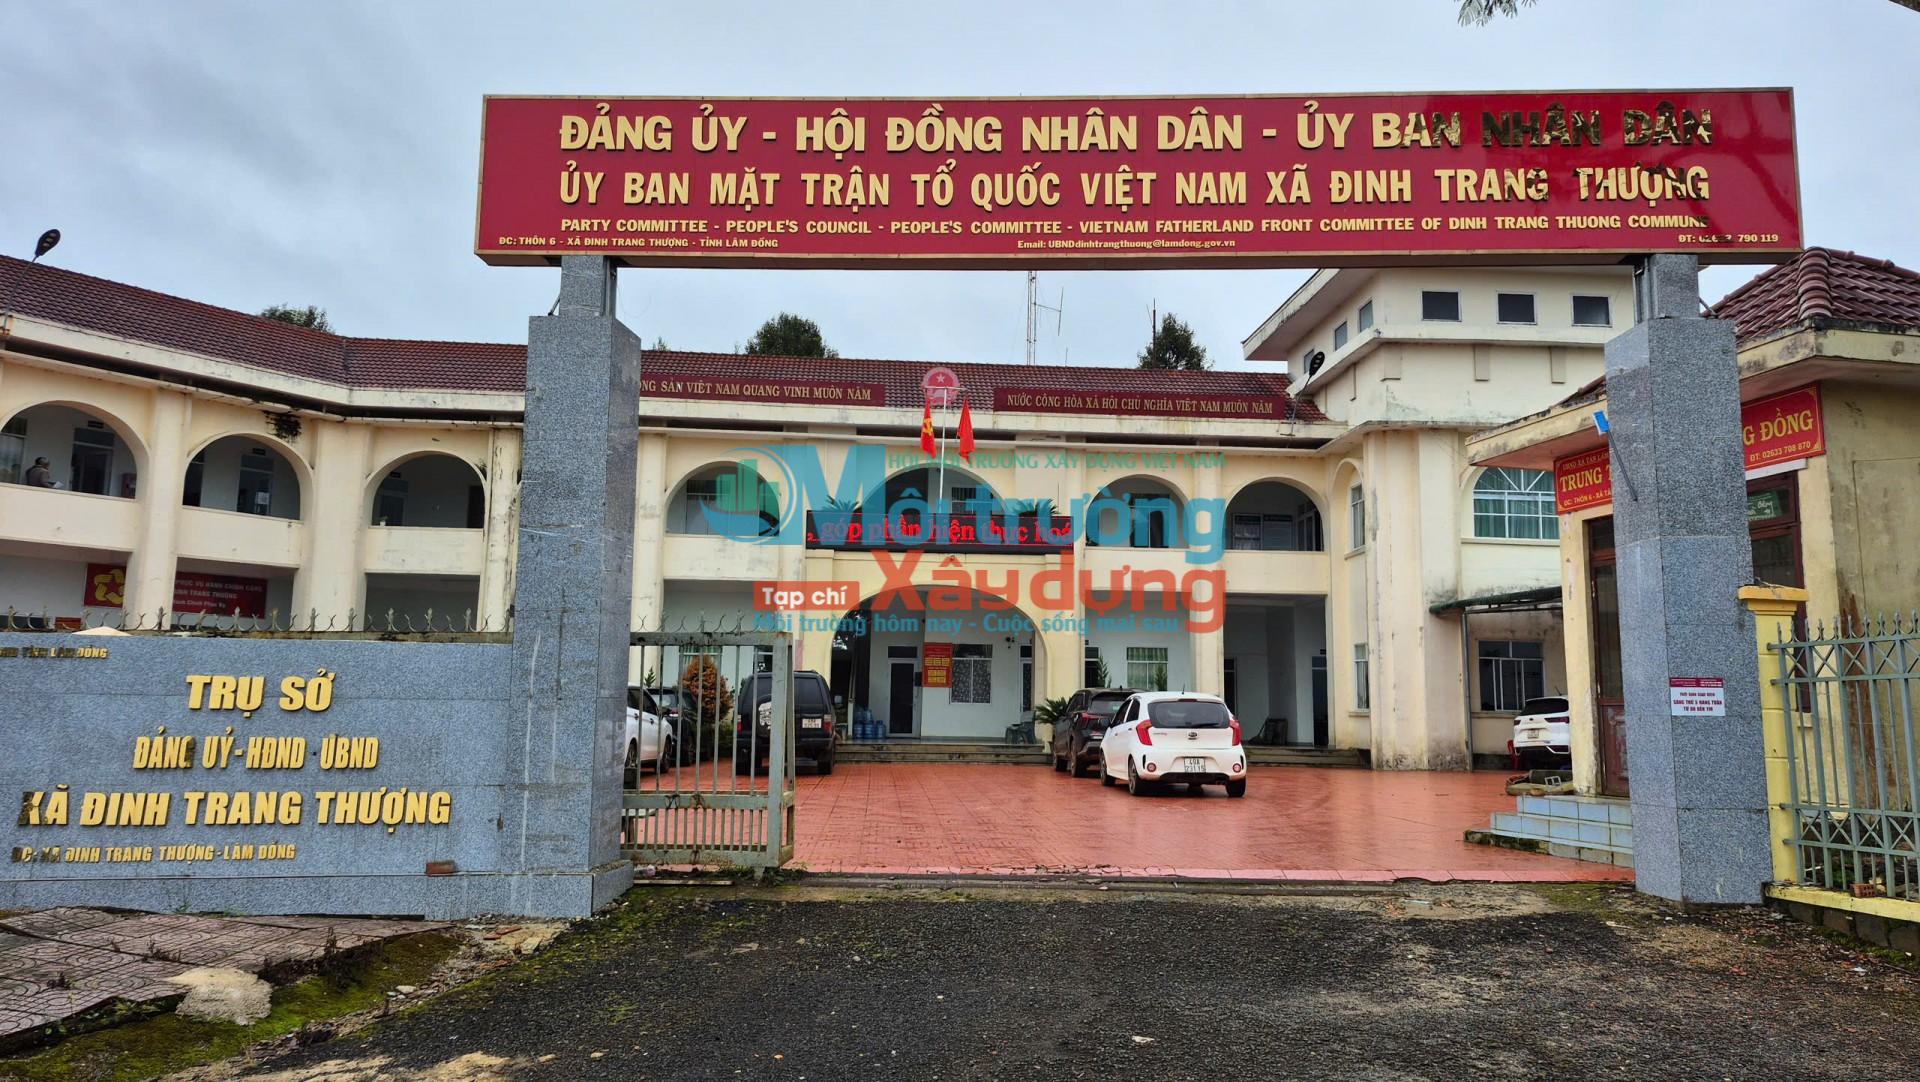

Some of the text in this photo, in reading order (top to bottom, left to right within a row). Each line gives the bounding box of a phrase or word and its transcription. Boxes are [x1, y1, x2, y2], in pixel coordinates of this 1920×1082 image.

[559, 104, 672, 152] ĐẢNG
[691, 104, 747, 152] ỦY
[795, 107, 866, 160] HỘI
[885, 103, 1002, 152] ĐỒNG
[1022, 107, 1138, 151] NHÂN
[1157, 106, 1243, 151] DÂN
[1297, 100, 1353, 150] ỦY
[1373, 111, 1461, 147] BAN
[1482, 102, 1601, 147] NHÂN
[1623, 101, 1714, 146] DÂN
[559, 158, 1709, 213] ỦY BAN MẶT TRẬN TỔ QUỐC VIỆT NAM XÃ ĐINH TRANG THƯỢNG
[561, 219, 610, 234] PARTY
[616, 219, 708, 234] COMMITTEE
[726, 219, 799, 234] PEOPLE'S
[806, 219, 872, 234] COUNCIL
[890, 219, 962, 234] PEOPLE'S
[970, 219, 1061, 234] COMMITTEE
[1079, 219, 1149, 234] VIETNAM
[1155, 219, 1254, 233] FATHERLAND
[1261, 218, 1314, 232] FRONT
[1319, 217, 1414, 232] COMMITTEE
[1421, 217, 1442, 231] OF
[1449, 216, 1487, 231] DINH
[1494, 216, 1550, 230] TRANG
[1556, 215, 1621, 230] THUONG
[499, 236, 516, 246] ĐC:
[519, 236, 546, 246] THÔN
[549, 237, 556, 246] 6
[567, 236, 581, 246] XÃ
[584, 237, 609, 247] ĐINH
[612, 238, 645, 247] TRANG
[649, 237, 689, 249] THƯỢNG
[699, 236, 723, 247] TỈNH
[726, 237, 748, 248] LÂM
[751, 237, 778, 248] ĐỒNG
[1018, 240, 1046, 249] Email:
[1678, 234, 1696, 243] ĐT:
[1738, 234, 1758, 242] 790
[1760, 234, 1779, 242] 119
[715, 383, 740, 395] NAM
[743, 384, 781, 397] QUANG
[784, 386, 810, 398] VINH
[813, 385, 844, 399] MUÔN
[1007, 391, 1033, 407] NƯỚC
[1035, 392, 1061, 407] CỘNG
[1102, 395, 1119, 410] HỘI
[1121, 394, 1141, 410] CHỦ
[1200, 400, 1221, 412] NAM
[1223, 399, 1249, 413] MUÔN
[1760, 407, 1814, 441] ĐỒNG
[1559, 467, 1603, 492] TRUNG
[186, 668, 336, 718] TRỤ SỞ
[132, 726, 195, 769] ĐẢNG
[18, 784, 452, 833] XÃ ĐINH TRANG THƯỢNG
[65, 847, 101, 863] ĐINH
[106, 847, 152, 862] TRANG
[258, 841, 296, 860] ĐỒNG
